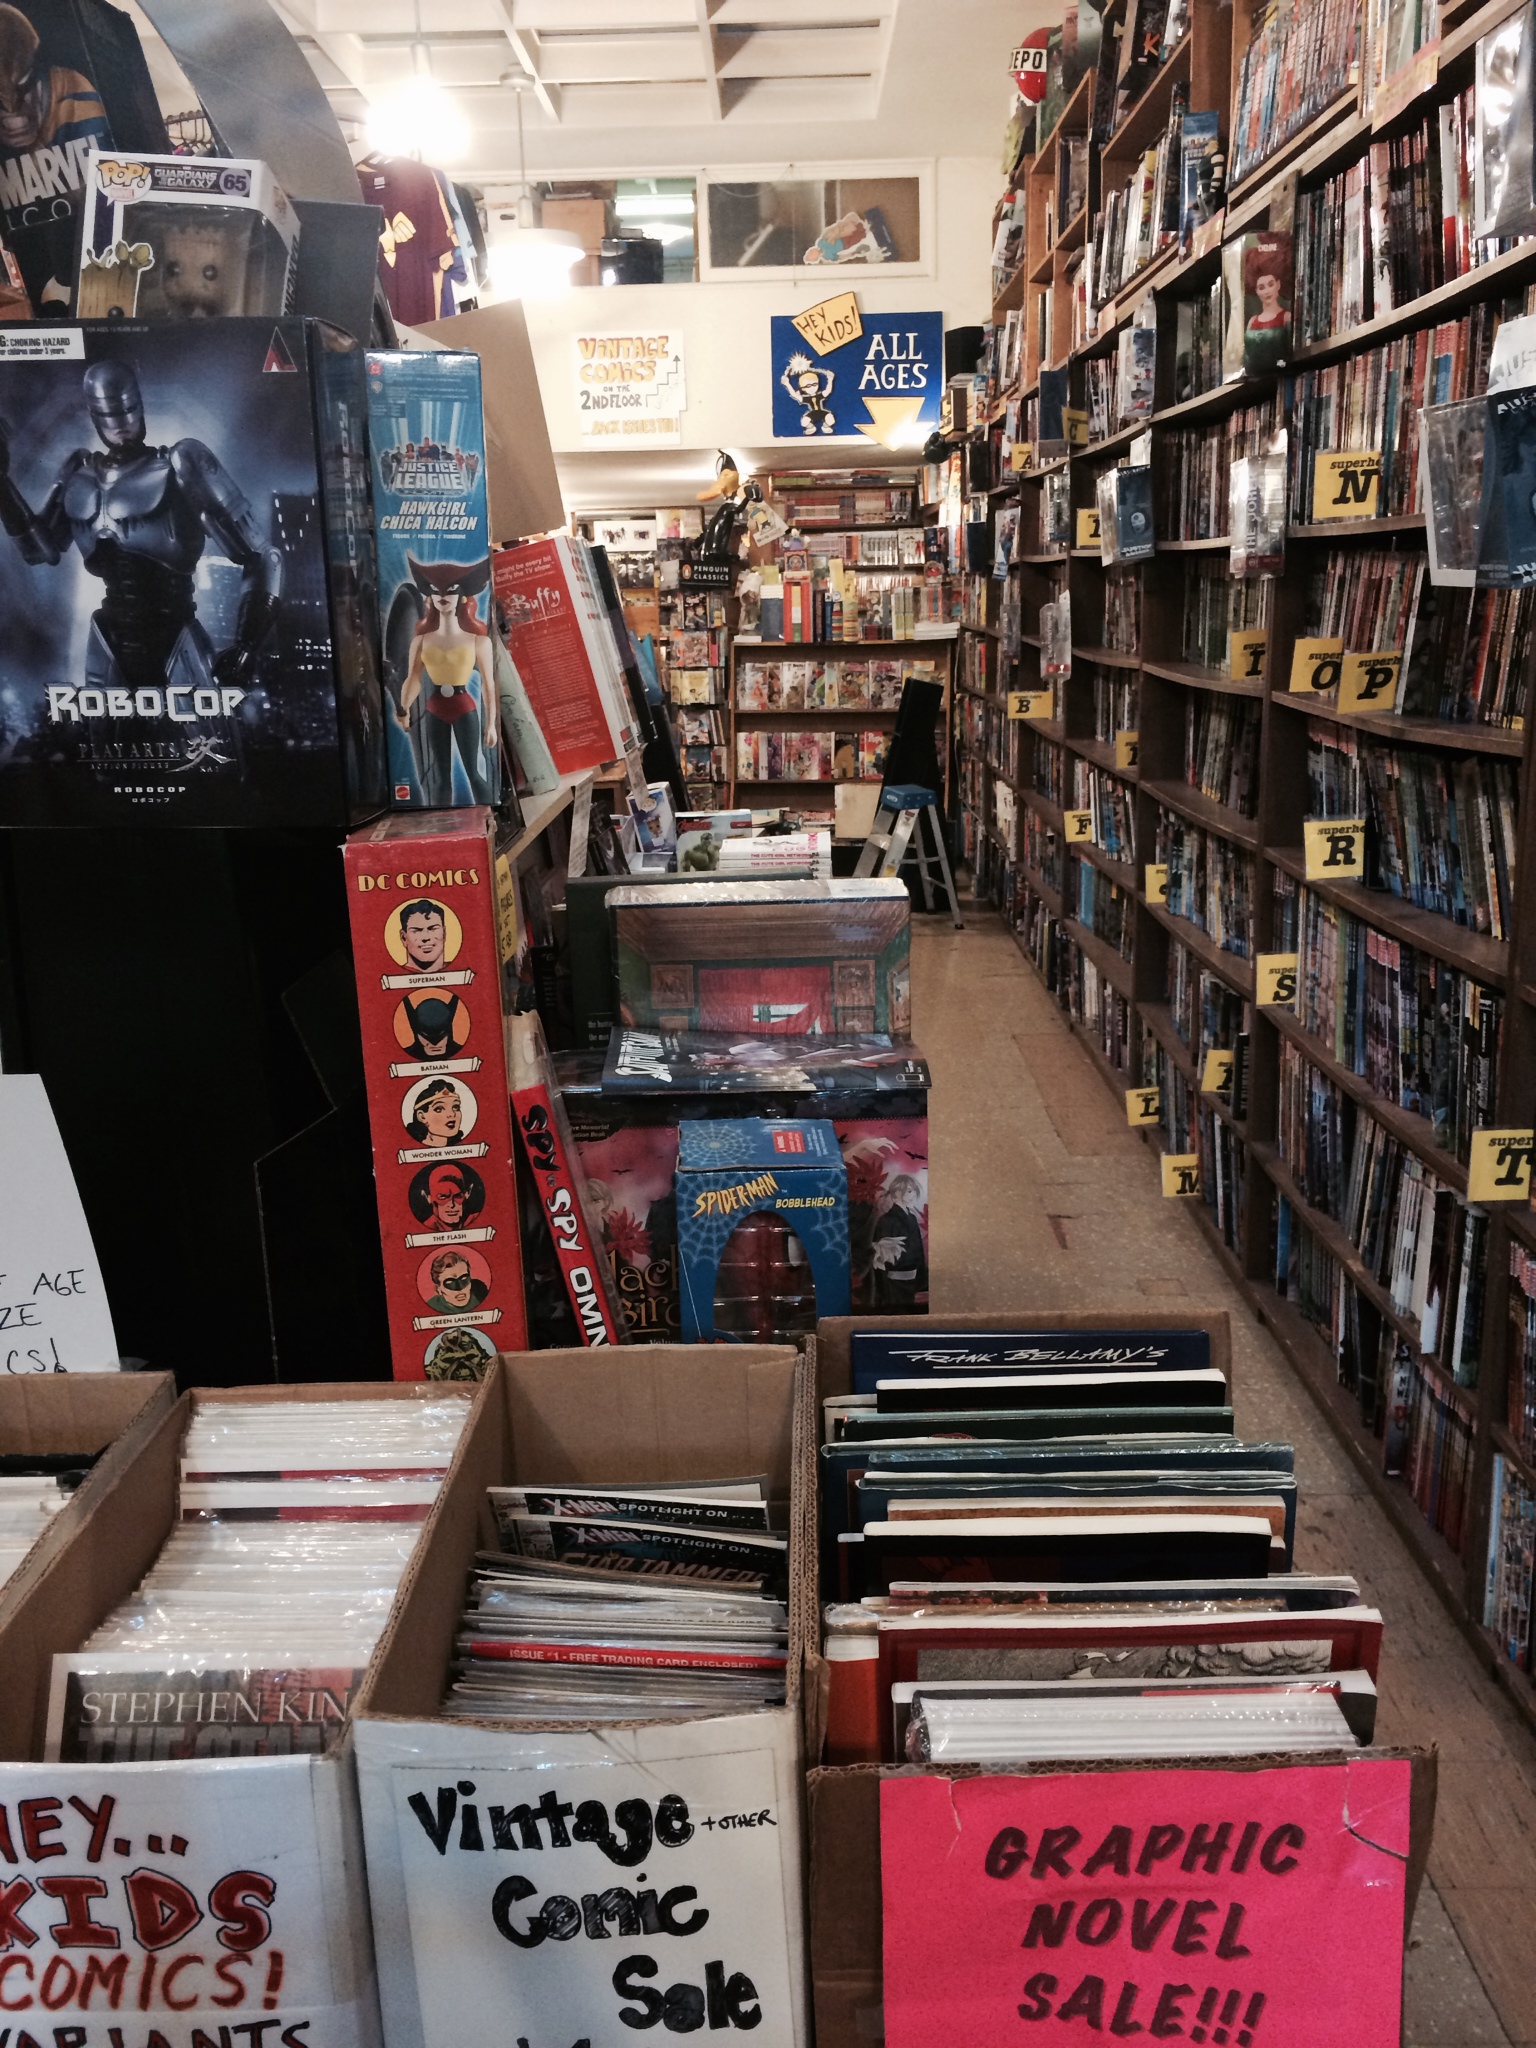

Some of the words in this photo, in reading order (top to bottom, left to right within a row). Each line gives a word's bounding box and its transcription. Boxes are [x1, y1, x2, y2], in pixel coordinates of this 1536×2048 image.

[0, 134, 100, 209] MARVE
[96, 160, 151, 189] POP!
[154, 169, 218, 181] GUARDIANS
[167, 179, 215, 189] GALAXY
[223, 174, 247, 192] 65
[796, 306, 826, 334] HEY
[814, 306, 859, 347] KIDS!
[10, 338, 41, 347] CHOKING
[43, 337, 71, 346] HAZARD
[865, 332, 922, 361] ALL
[603, 385, 613, 393] ON
[616, 384, 630, 392] THE
[858, 363, 929, 390] AGES
[609, 394, 643, 409] FLOOR
[395, 473, 464, 489] LEAGUE
[398, 462, 459, 473] JUSTICE
[1332, 468, 1380, 505] N
[399, 501, 467, 515] HAWKGIRL
[380, 515, 422, 530] CHICA
[425, 516, 478, 531] HALCON
[694, 565, 729, 573] PENGUIN
[508, 587, 560, 621] Buffy
[1311, 660, 1341, 690] O
[1357, 666, 1394, 700] P
[1016, 699, 1031, 714] B
[78, 742, 124, 759] PLAY
[1075, 818, 1092, 835] F
[1323, 835, 1357, 866] R
[358, 873, 391, 892] DC
[396, 868, 480, 889] COMICS
[408, 975, 446, 985] SUPERMAN
[1272, 974, 1297, 1002] S
[420, 1063, 450, 1072] BATMAN
[521, 1103, 561, 1172] SPY
[580, 1123, 610, 1131] Memorial
[412, 1149, 443, 1159] WONDER
[444, 1147, 474, 1156] WOMAN
[1494, 1149, 1532, 1186] T
[691, 1171, 780, 1219] SPIDER-MAN
[775, 1196, 835, 1209] BOBBLEHEAD
[547, 1187, 584, 1251] SPY
[432, 1235, 445, 1243] THE
[447, 1233, 467, 1241] FLASH
[33, 1269, 86, 1296] AGE
[0, 1302, 42, 1331] ZE
[430, 1316, 452, 1326] GREEN
[454, 1314, 484, 1323] LANTERN
[889, 1349, 997, 1363] FRANK
[542, 1498, 618, 1517] X-MEN
[618, 1502, 703, 1517] SPOTLIGHT
[706, 1509, 728, 1518] ON
[567, 1525, 643, 1545] X-MEN
[642, 1533, 726, 1551] SPOTLIGHT
[729, 1544, 751, 1554] ON
[509, 1648, 544, 1660] ISSUE
[569, 1652, 599, 1664] FREE
[600, 1654, 655, 1666] TRADING
[656, 1658, 689, 1667] CARD
[80, 1691, 261, 1724] STEPHEN
[278, 1691, 350, 1723] KIN
[407, 1780, 694, 1867] Vintage
[984, 1821, 1306, 1880] GRAPHIC
[0, 1867, 277, 1953] KIDS
[492, 1873, 710, 1949] Comic
[1021, 1897, 1252, 1960] NOVEL
[0, 1949, 284, 2012] COMICS!
[612, 1954, 762, 2034] Sale
[1017, 1971, 1267, 2048] SALE!!!
